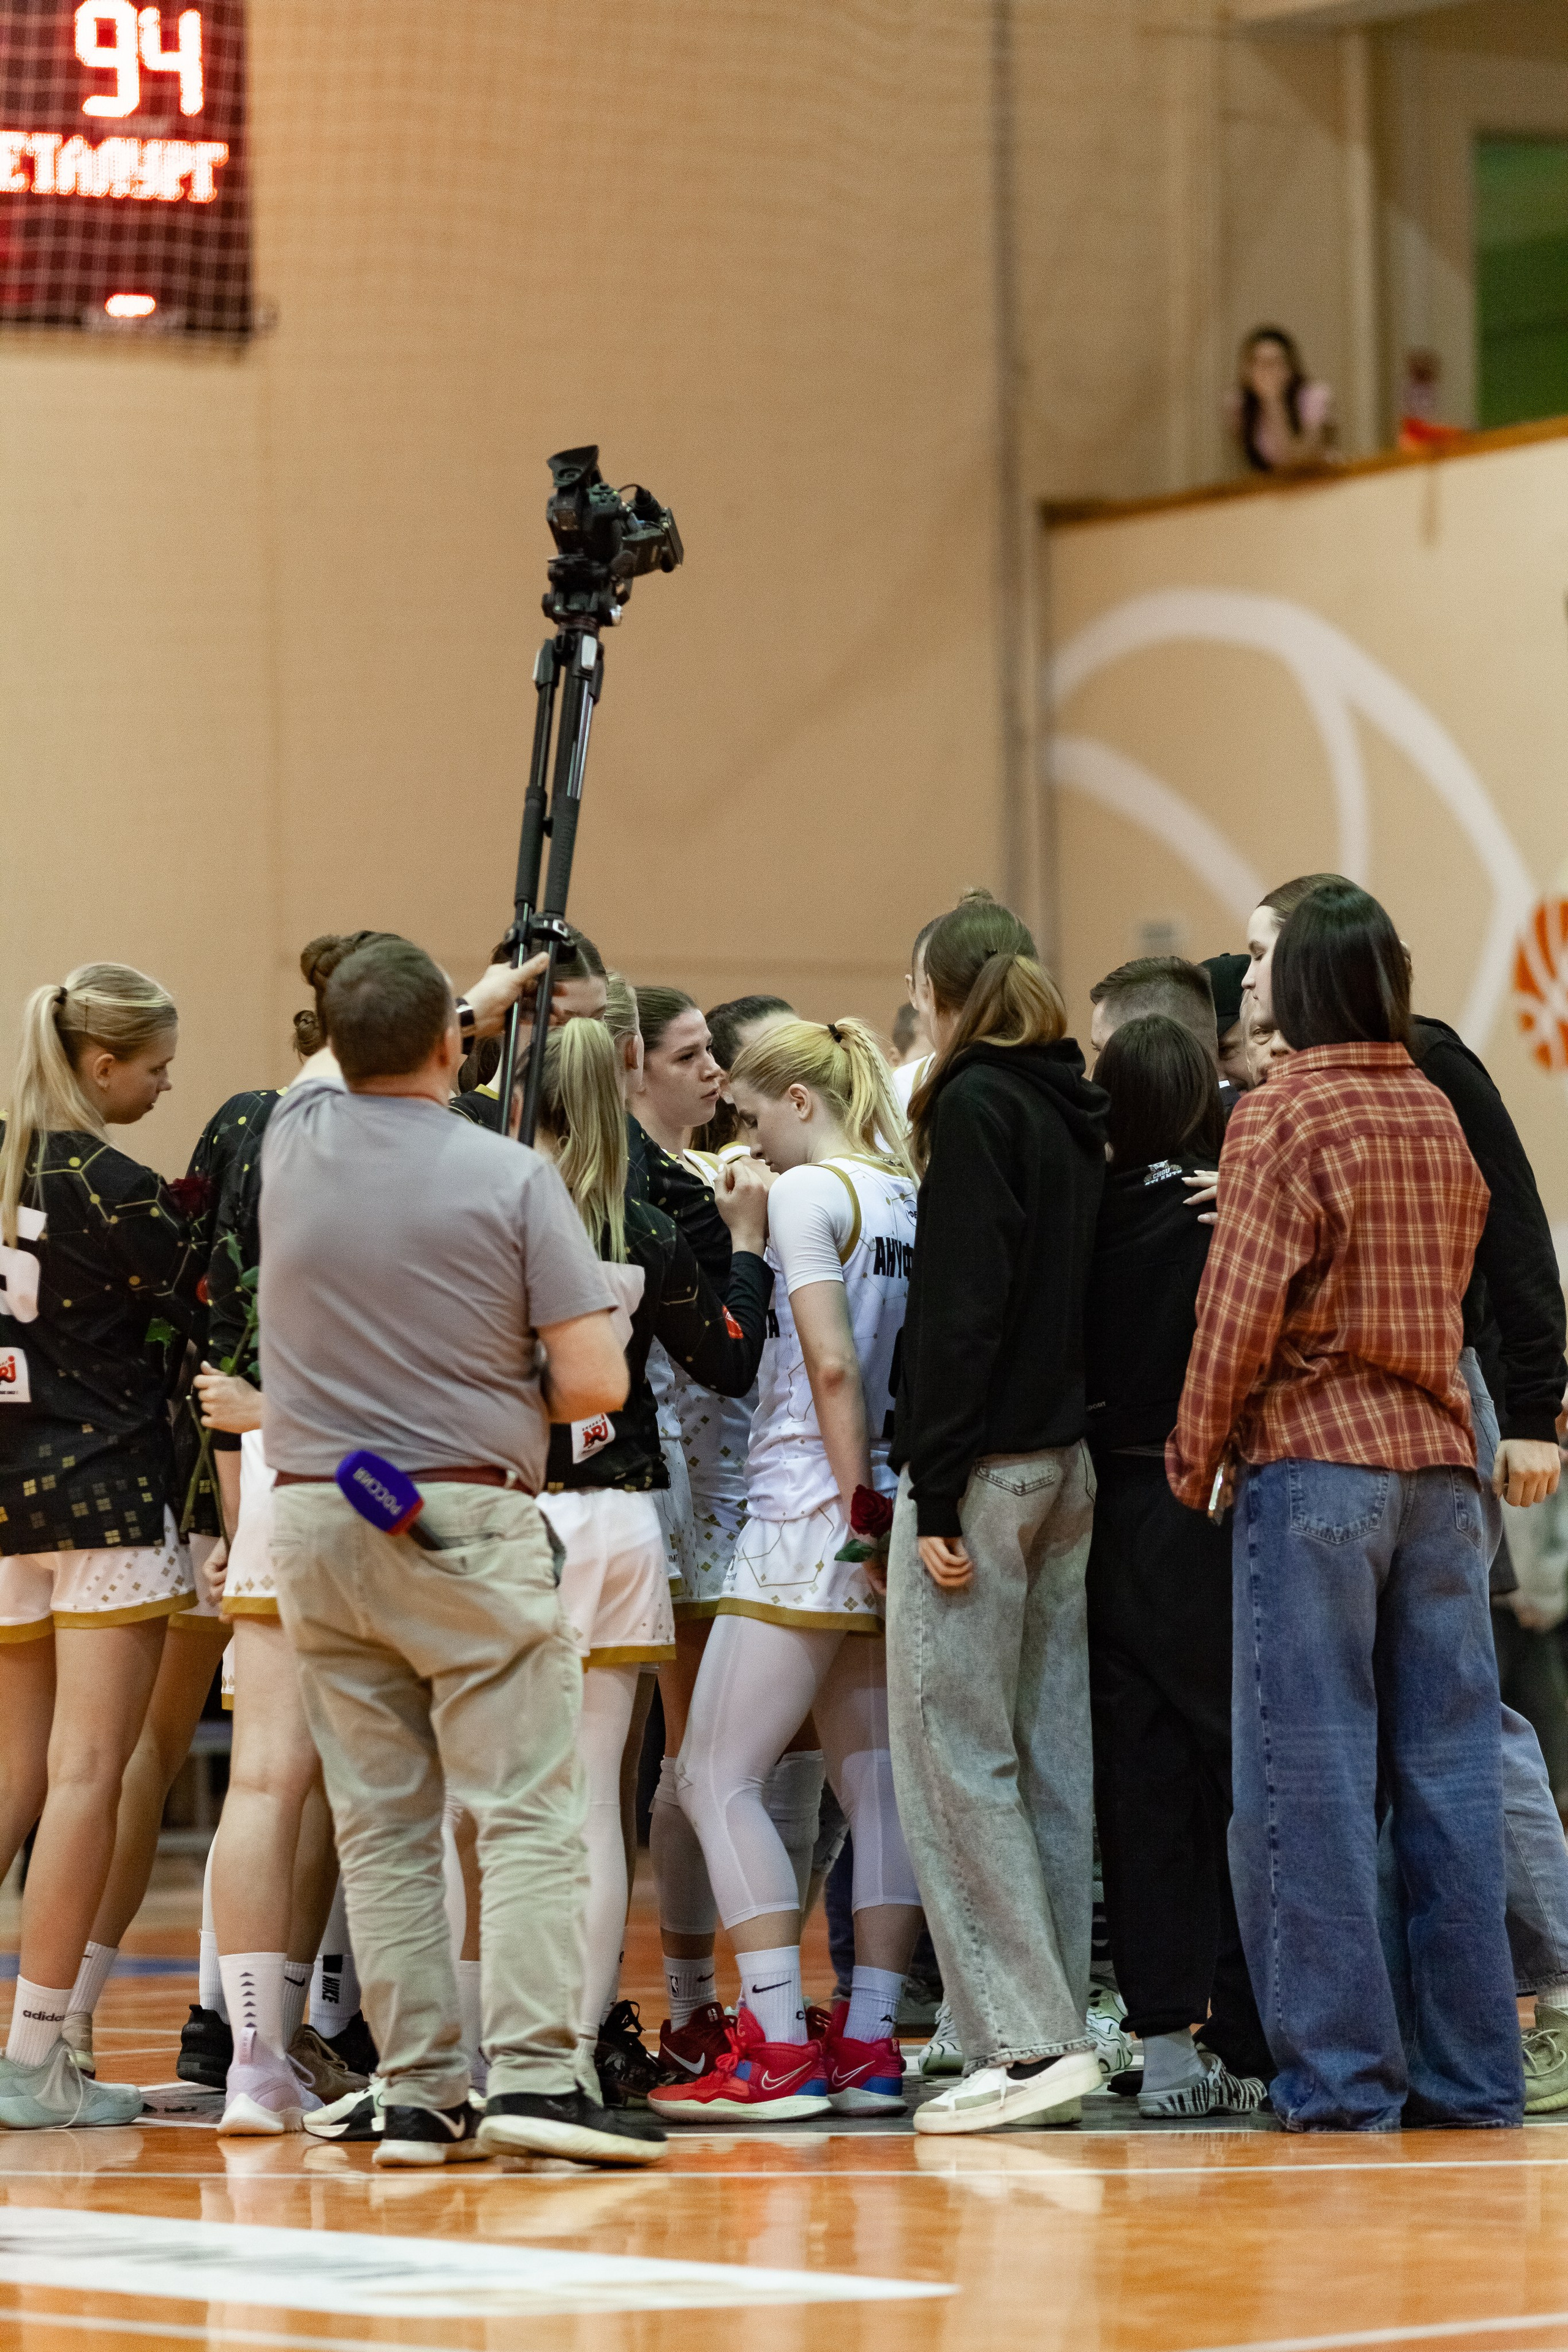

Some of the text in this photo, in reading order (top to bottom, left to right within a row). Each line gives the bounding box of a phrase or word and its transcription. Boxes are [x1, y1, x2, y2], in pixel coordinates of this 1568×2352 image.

[75, 0, 204, 118] 94
[352, 1466, 403, 1516] РОССИЯ
[322, 1974, 340, 2004] NIKE
